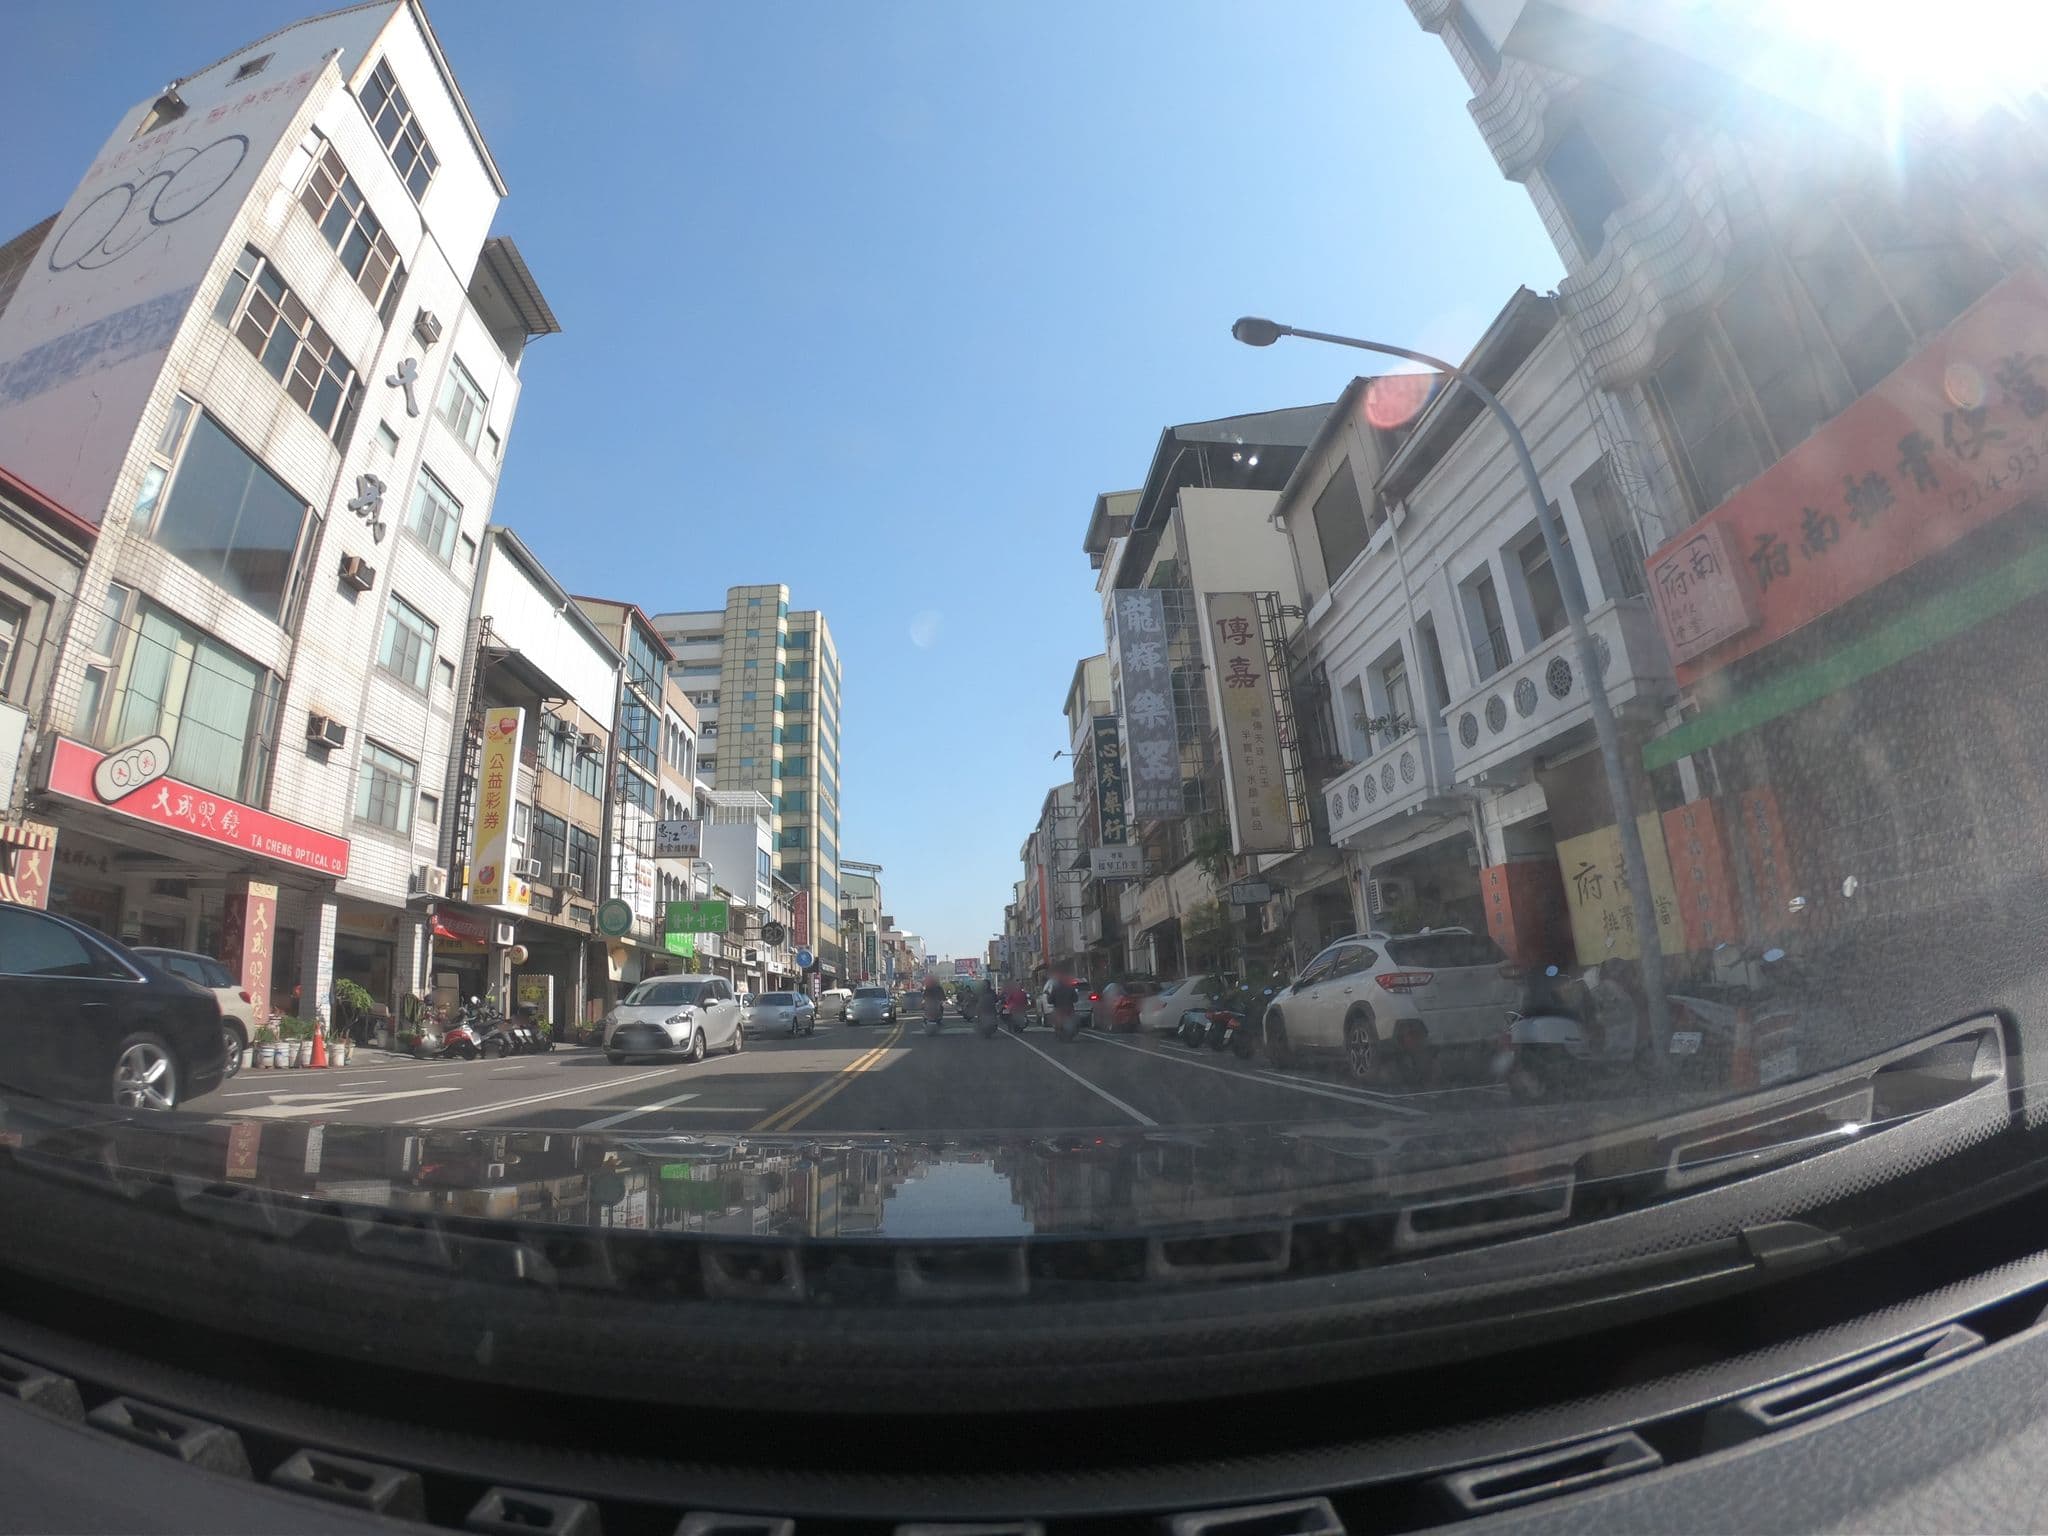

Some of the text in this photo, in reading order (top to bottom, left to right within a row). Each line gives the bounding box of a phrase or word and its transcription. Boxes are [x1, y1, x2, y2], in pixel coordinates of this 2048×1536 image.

[1119, 595, 1173, 781] 龍輝樂器
[1216, 617, 1261, 689] 傳嘉
[152, 787, 240, 839] 大成眼鏡
[483, 753, 505, 829] 公益彩券
[251, 834, 343, 872] TA CHENG OPTICAL CO.
[249, 902, 269, 1019] 大成眼鏡
